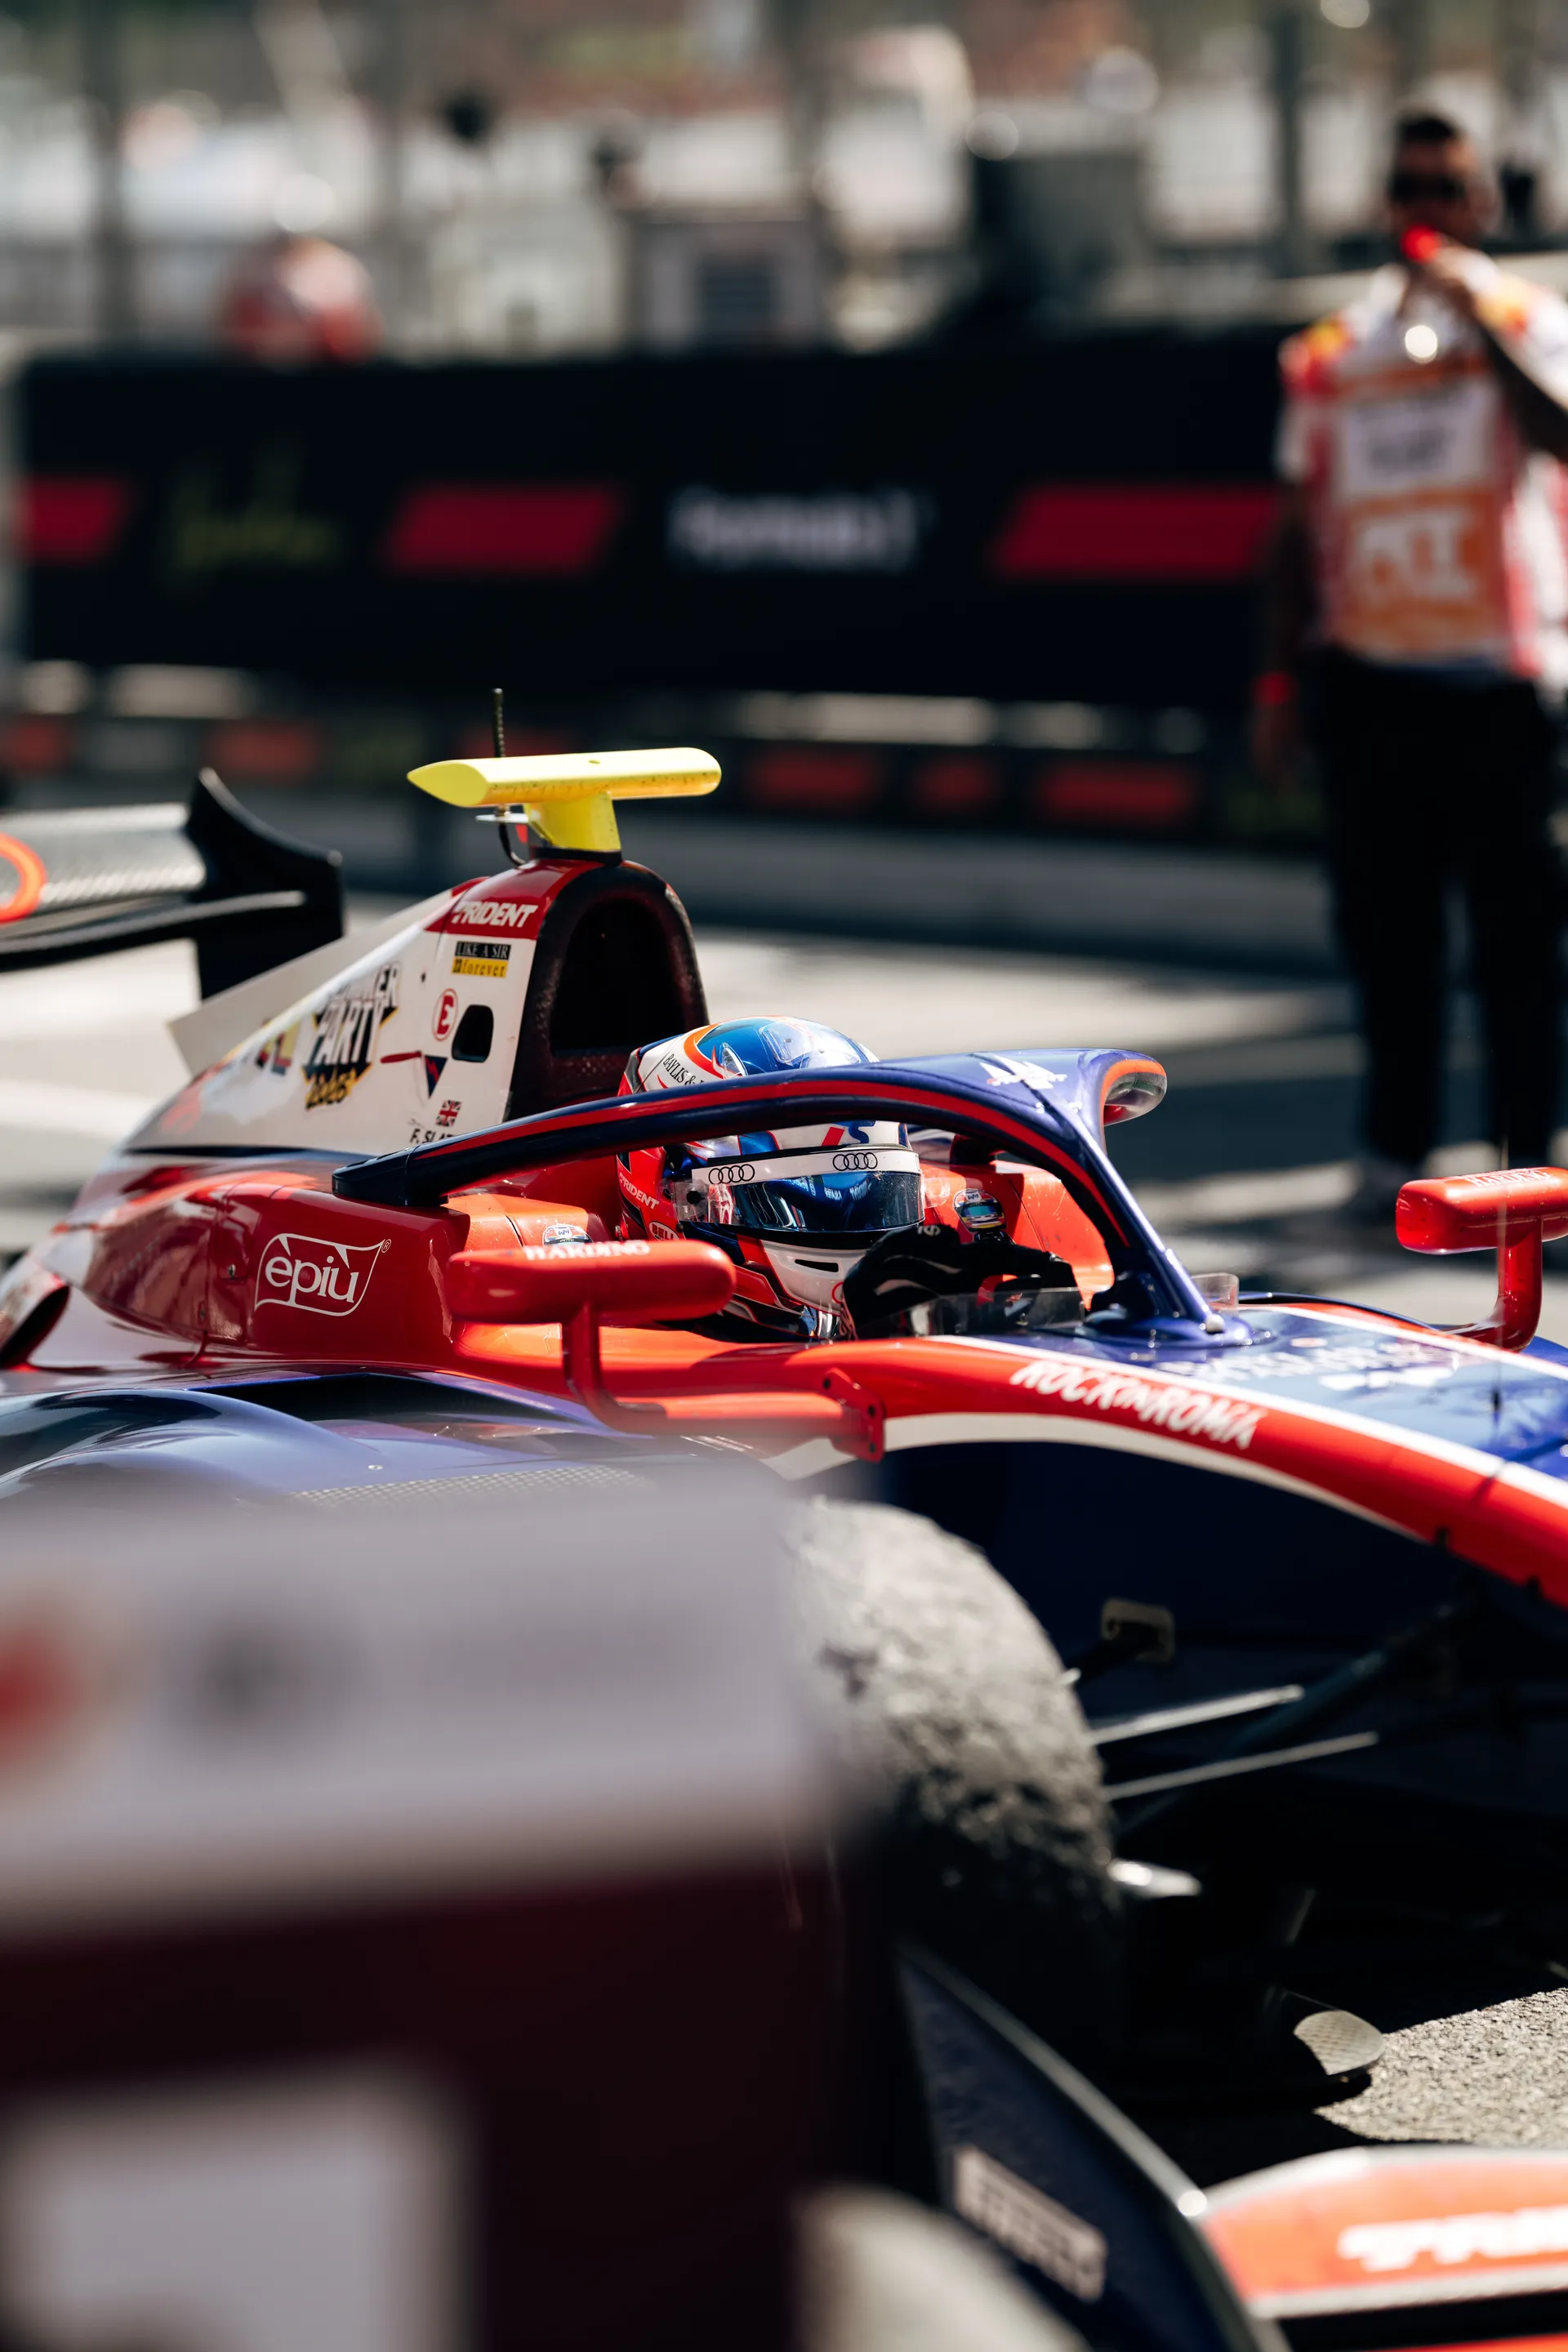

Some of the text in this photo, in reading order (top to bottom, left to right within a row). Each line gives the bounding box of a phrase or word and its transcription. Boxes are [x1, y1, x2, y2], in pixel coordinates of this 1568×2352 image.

[452, 901, 538, 928] TRIDENT
[492, 944, 509, 959] SIR
[663, 1054, 688, 1084] BAYLIS
[619, 1172, 659, 1209] TRIDENT
